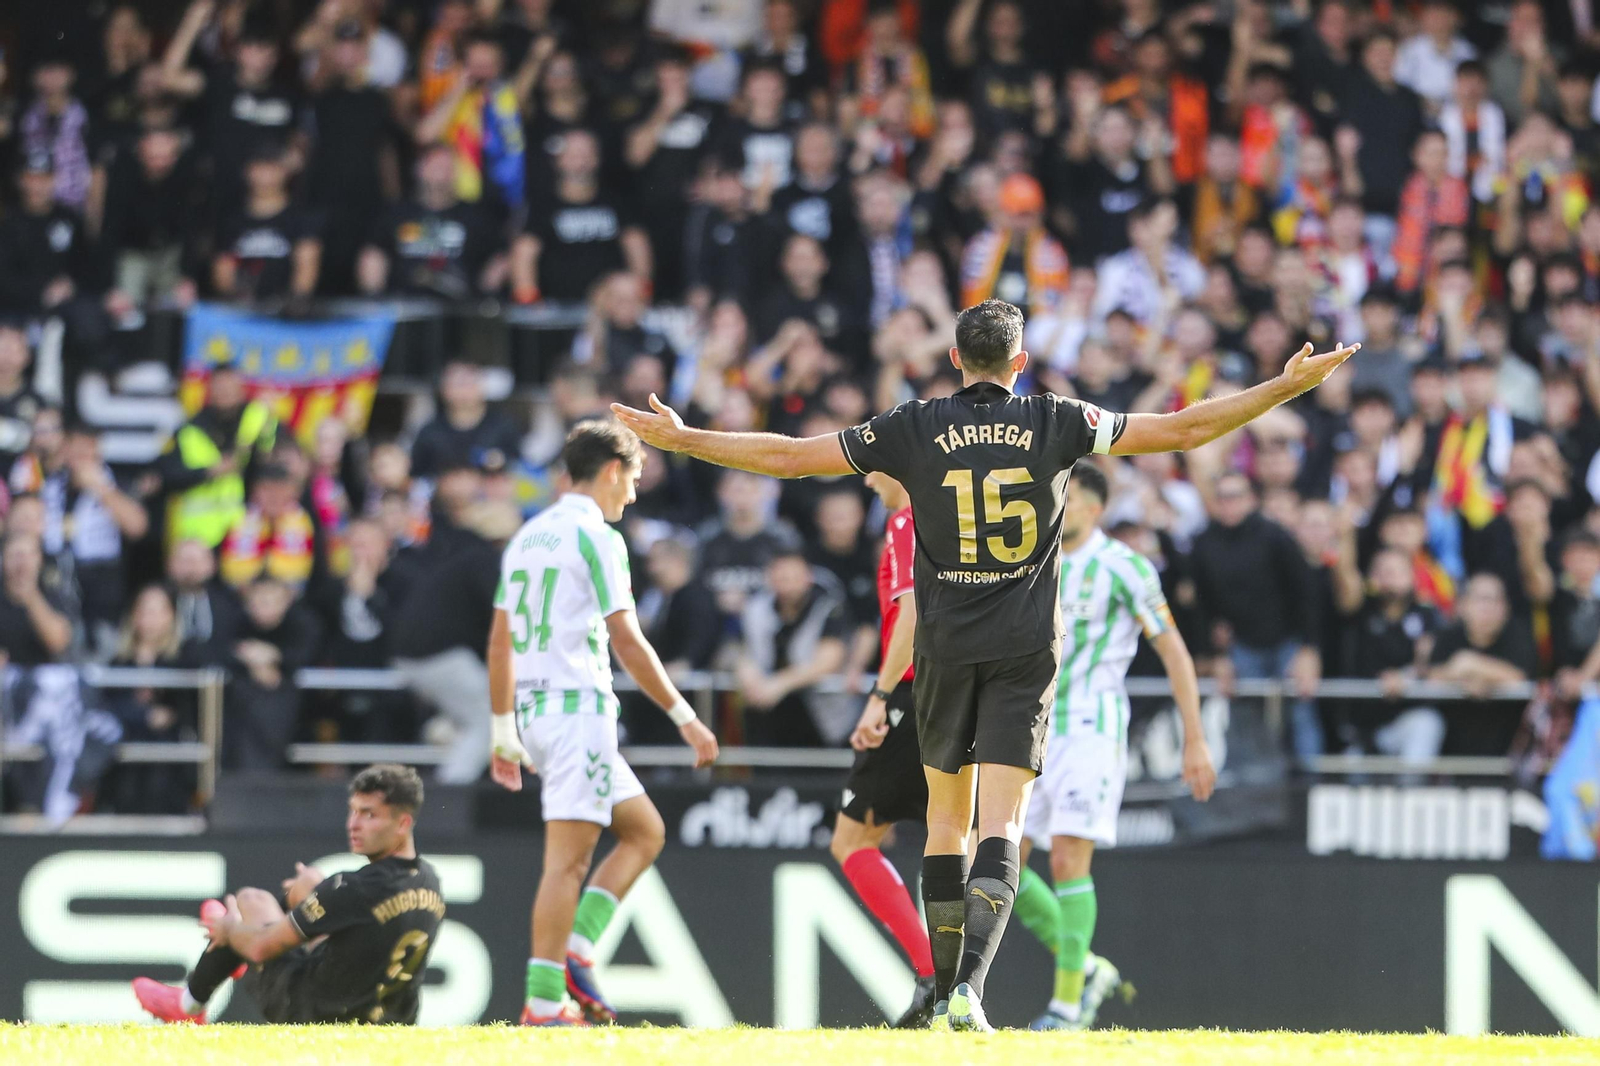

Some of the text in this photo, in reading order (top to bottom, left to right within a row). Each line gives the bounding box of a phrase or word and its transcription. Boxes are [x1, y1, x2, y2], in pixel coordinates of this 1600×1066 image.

[934, 423, 1034, 454] TÁRREGA
[941, 467, 1038, 563] 15
[521, 531, 562, 554] GUIRAO
[937, 571, 972, 584] UNITS
[510, 567, 560, 654] 34
[1306, 784, 1510, 860] PUMA
